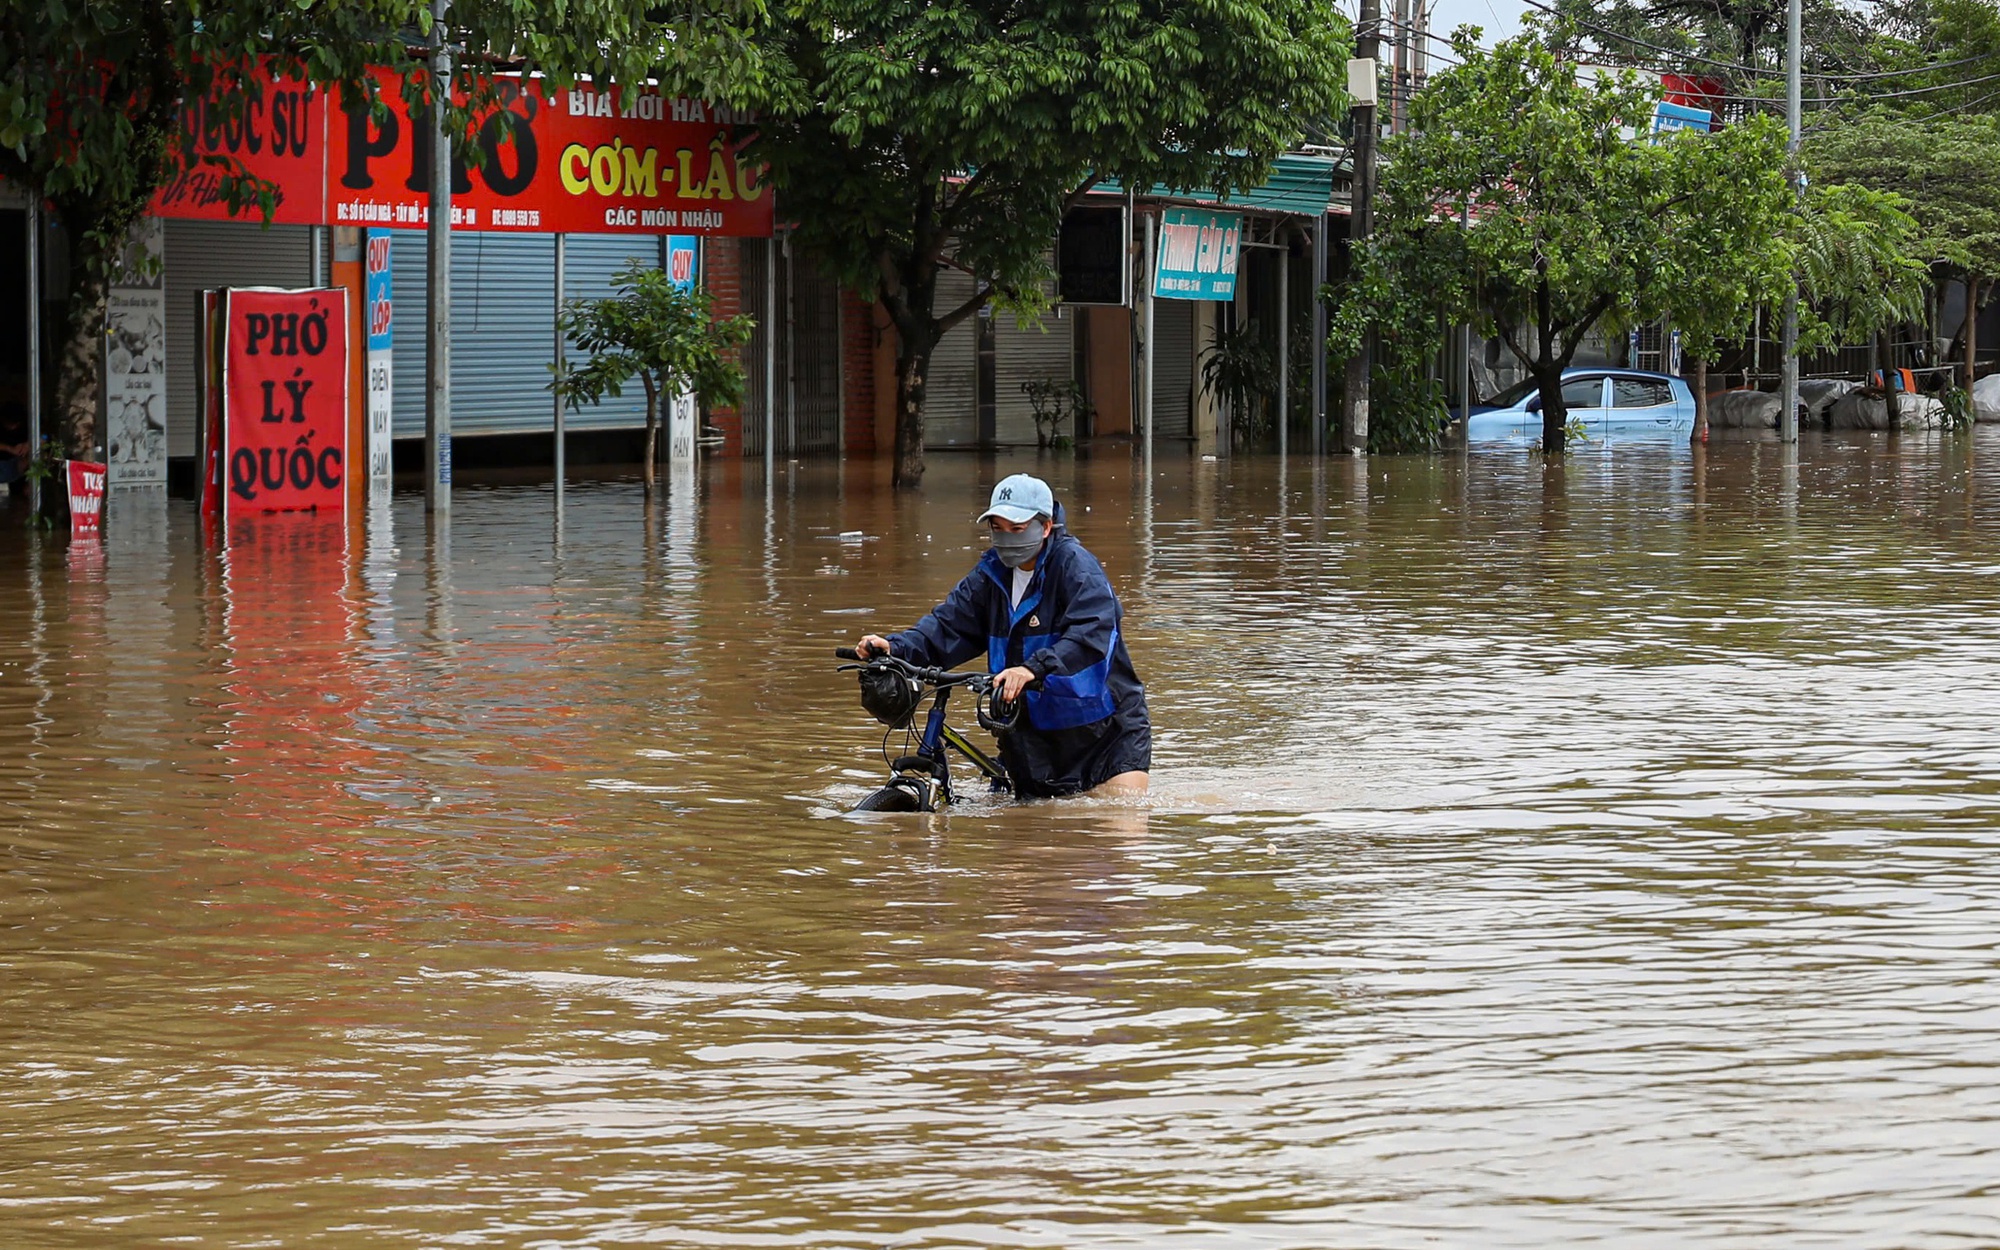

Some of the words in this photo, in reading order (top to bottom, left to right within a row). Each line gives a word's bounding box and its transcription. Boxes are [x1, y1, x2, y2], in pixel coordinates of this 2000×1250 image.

[568, 90, 613, 117] BIA
[605, 206, 637, 226] CÁC
[641, 206, 677, 228] MÓN
[682, 208, 723, 231] NHẬU
[245, 298, 329, 356] PHỞ
[261, 367, 313, 423] LÝ
[231, 429, 341, 501] QUỐC
[998, 486, 1013, 501] NY
